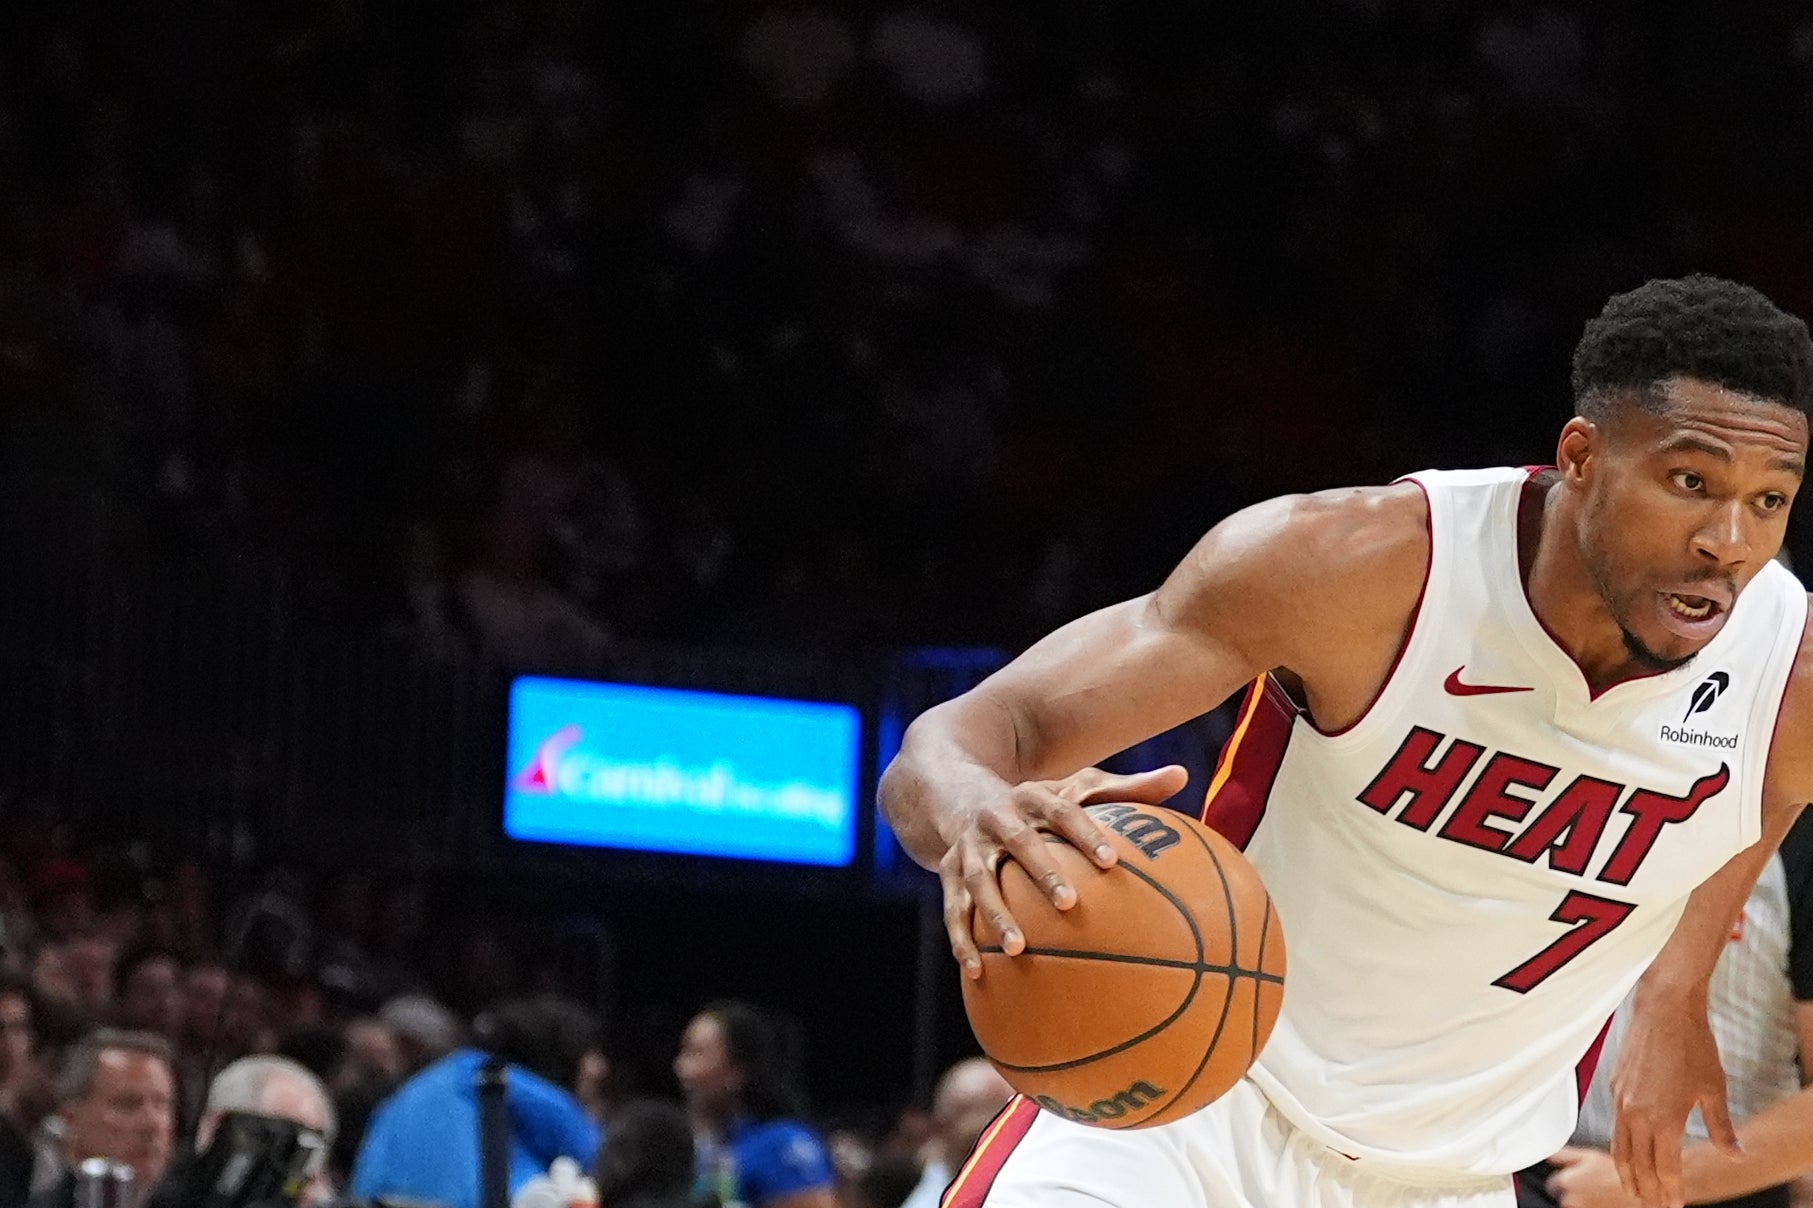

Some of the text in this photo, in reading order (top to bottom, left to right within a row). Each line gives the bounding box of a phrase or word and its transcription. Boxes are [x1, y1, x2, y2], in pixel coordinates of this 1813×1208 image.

[1660, 725, 1738, 750] Robinhood
[1356, 725, 1730, 887] HEAT
[1490, 889, 1639, 994] 7
